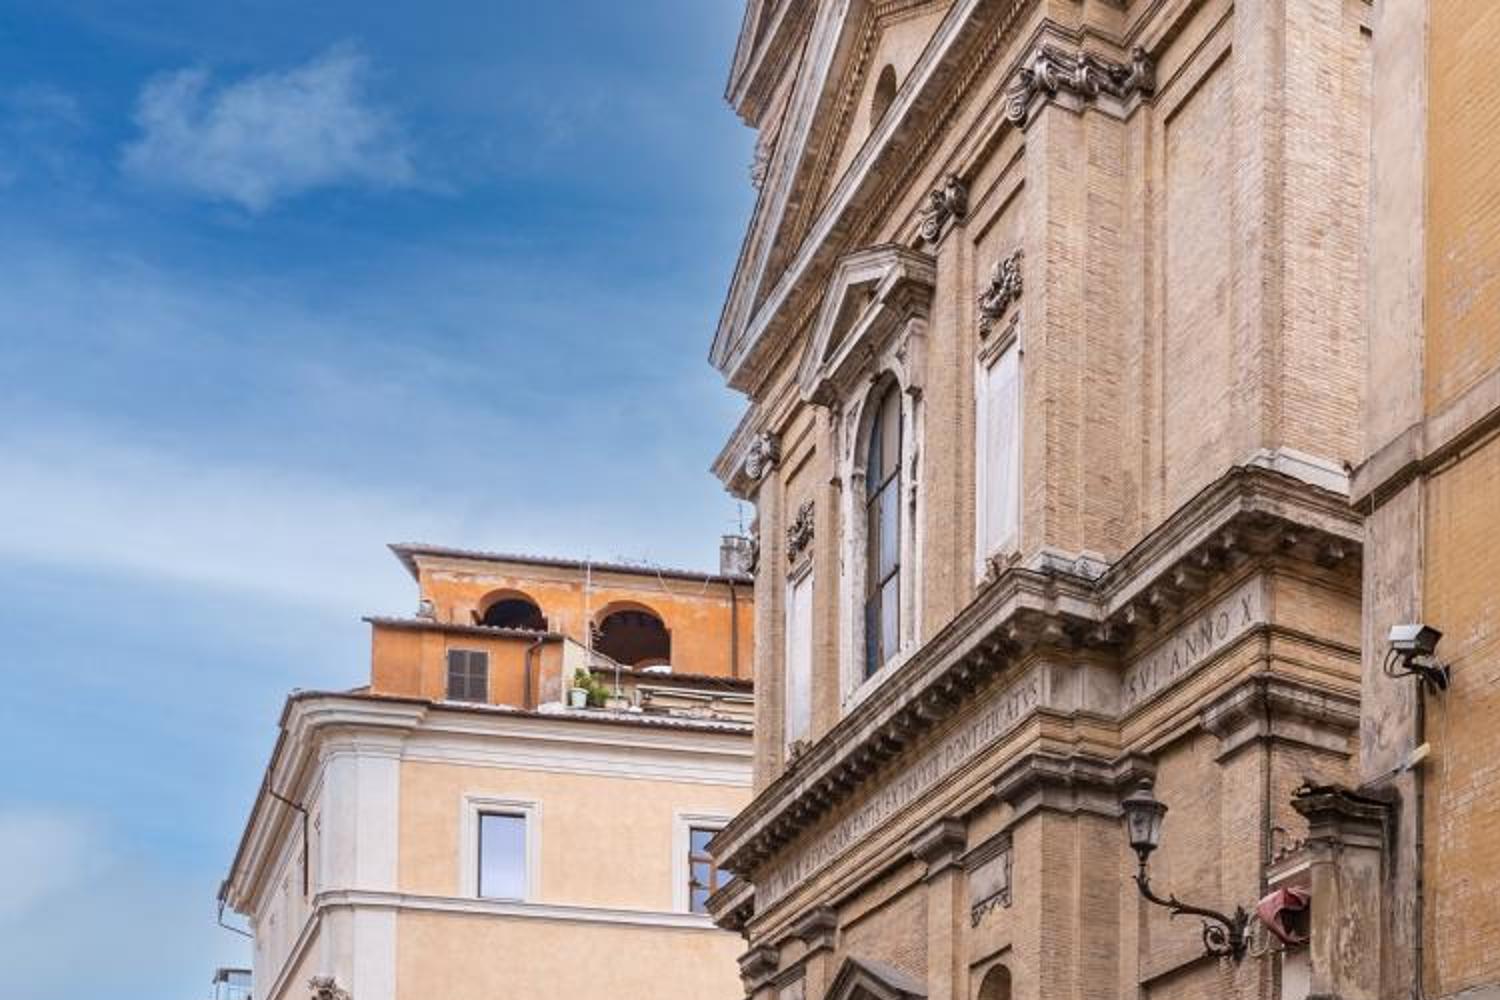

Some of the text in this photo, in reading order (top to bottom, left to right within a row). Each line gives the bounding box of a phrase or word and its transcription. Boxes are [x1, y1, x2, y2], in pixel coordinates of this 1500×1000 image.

[1128, 660, 1158, 699] SVI
[1169, 611, 1230, 676] ANNO
[1240, 594, 1252, 626] X
